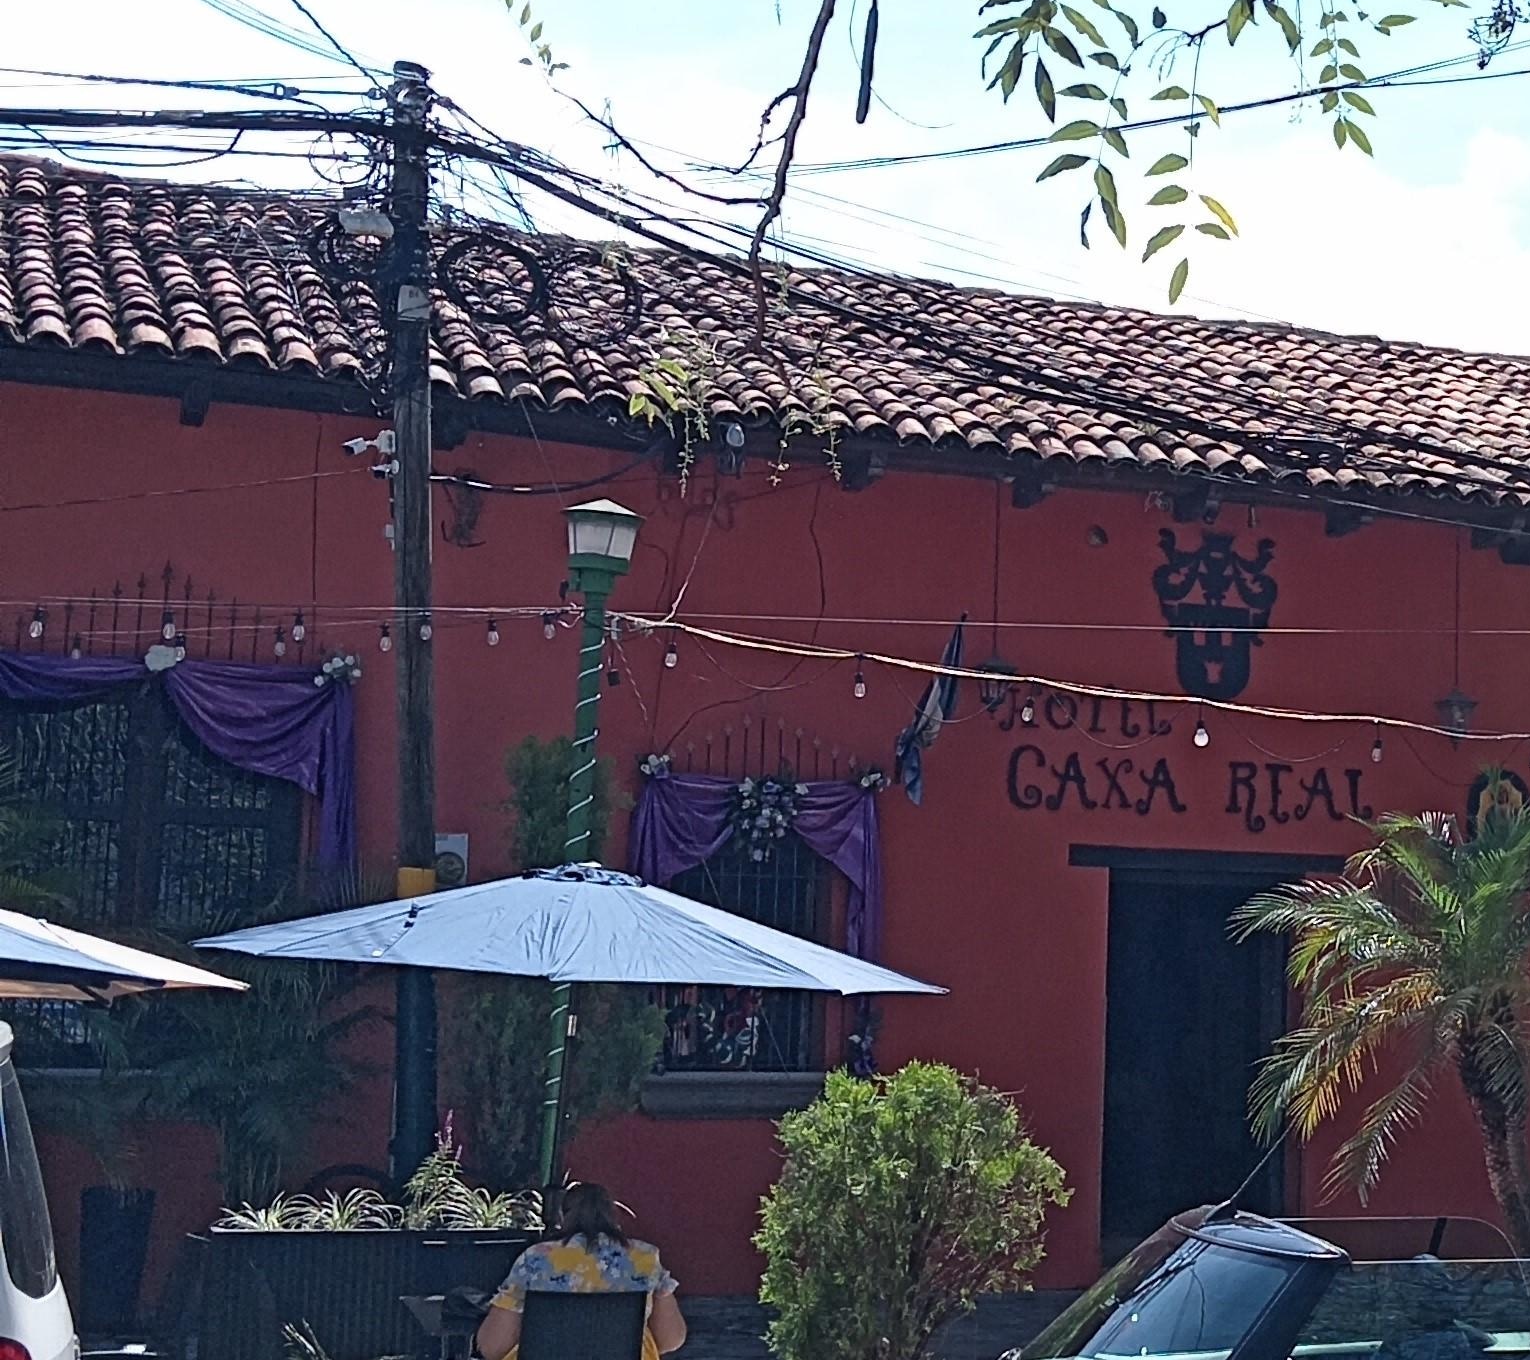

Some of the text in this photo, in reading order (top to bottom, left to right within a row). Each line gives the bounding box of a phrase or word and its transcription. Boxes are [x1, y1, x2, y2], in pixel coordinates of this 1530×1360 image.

[999, 683, 1172, 738] HOTEL
[1006, 744, 1373, 833] CAXA REAL
